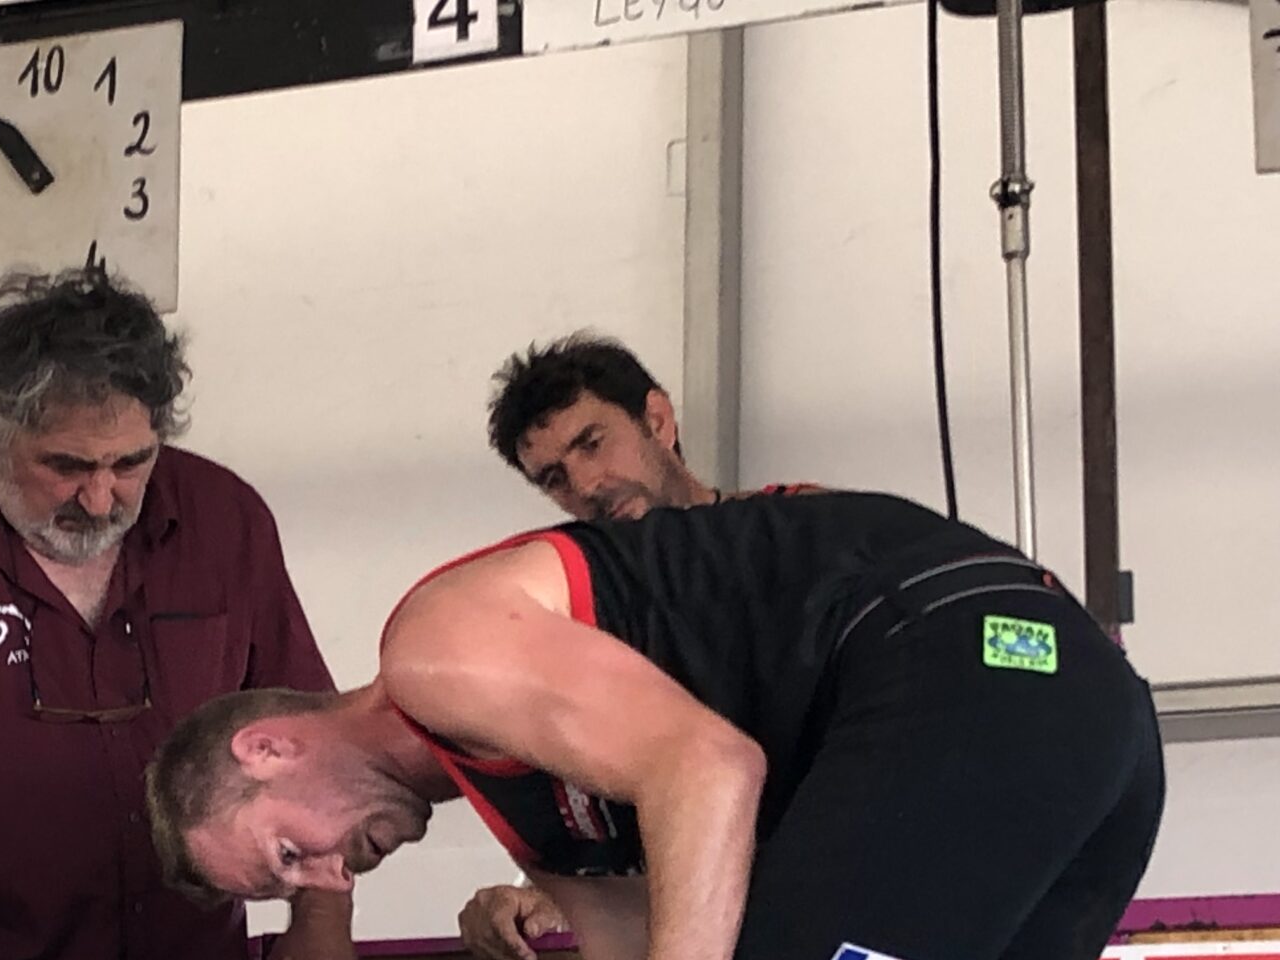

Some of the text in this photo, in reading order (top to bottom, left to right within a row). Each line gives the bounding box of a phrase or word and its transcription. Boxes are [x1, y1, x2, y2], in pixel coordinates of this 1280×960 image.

[427, 0, 478, 42] 4
[18, 45, 65, 98] 10
[93, 56, 117, 106] 1
[124, 110, 157, 157] 2
[123, 177, 150, 220] 3
